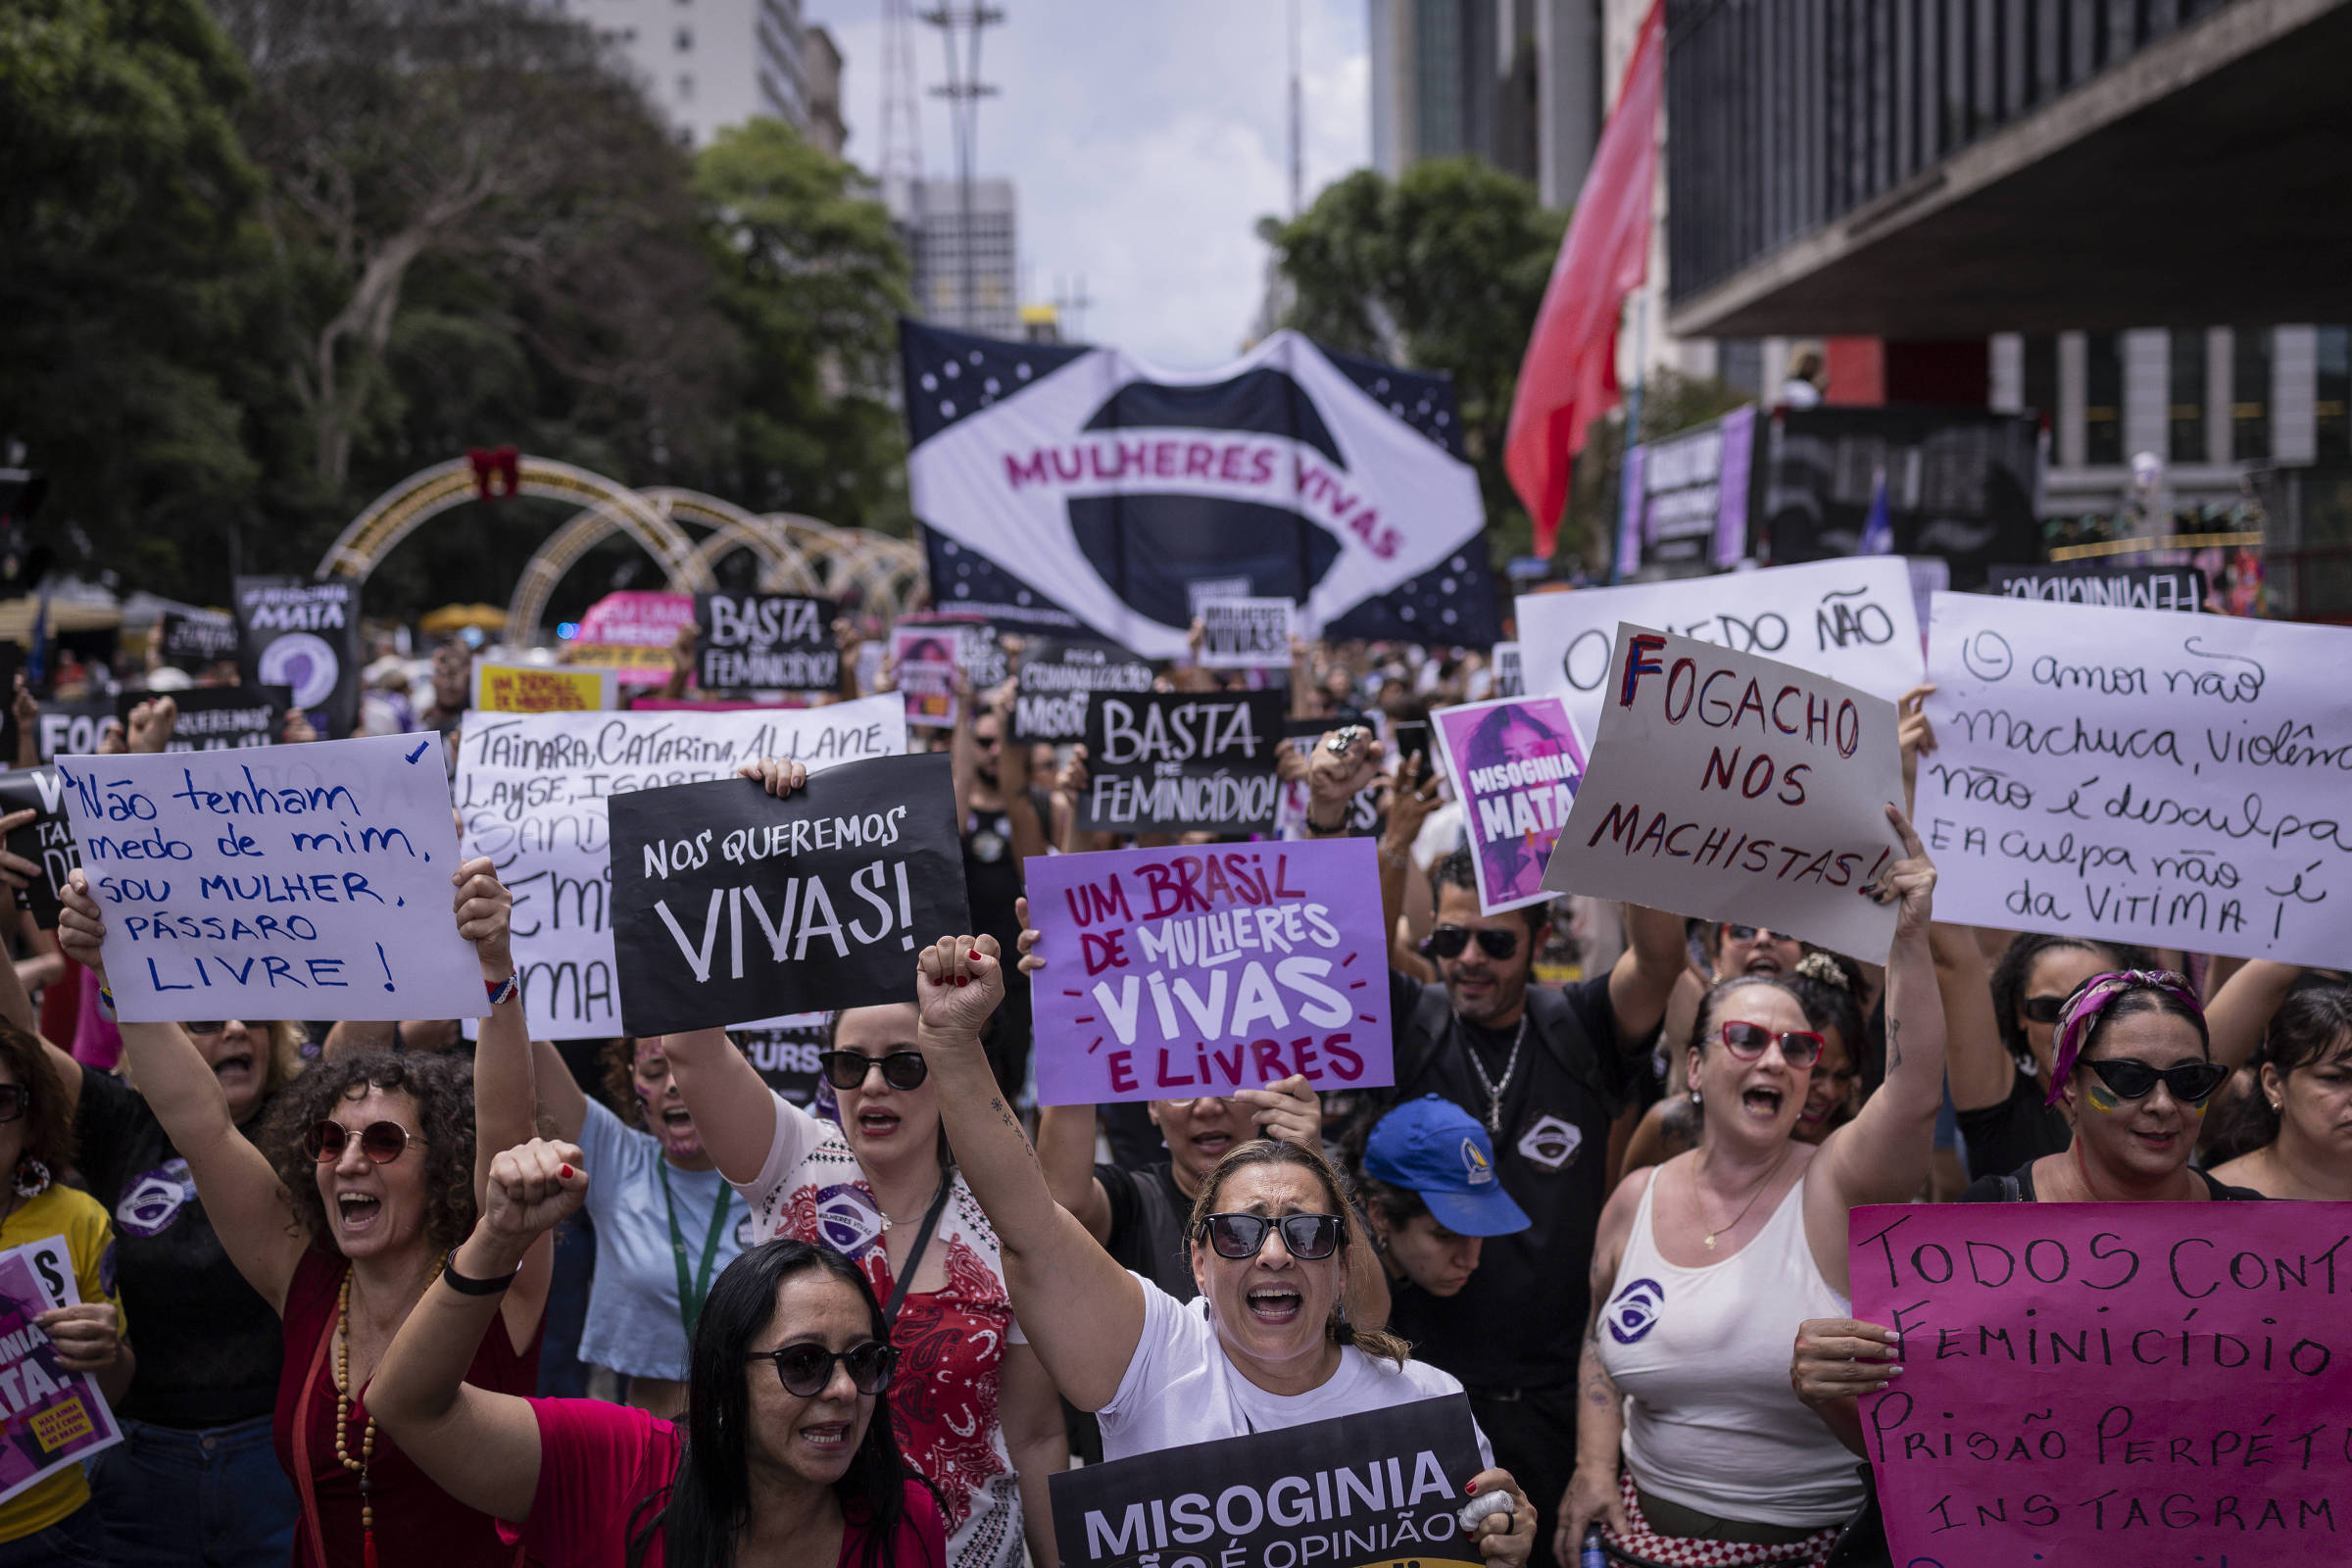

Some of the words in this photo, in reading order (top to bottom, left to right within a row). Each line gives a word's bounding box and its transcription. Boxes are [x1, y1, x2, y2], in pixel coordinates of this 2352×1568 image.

[1004, 438, 1276, 489] MULHERES
[1295, 455, 1400, 561] VIVAS
[709, 595, 822, 647] BASTA
[1563, 629, 1611, 690] O
[1817, 585, 1894, 652] NÃO
[1620, 634, 1859, 760] FOGACHO
[2033, 655, 2149, 695] amor
[2163, 636, 2266, 704] não
[1101, 699, 1263, 764] BASTA
[173, 764, 361, 816] tenham
[1090, 767, 1278, 823] FEMINICÍDIO!
[1469, 752, 1581, 795] MISOGINIA
[1700, 745, 1812, 807] NOS
[88, 827, 193, 861] medo
[218, 822, 264, 858] de
[643, 829, 711, 880] NOS
[721, 805, 906, 866] QUEREMOS
[1478, 783, 1575, 844] MATA
[2104, 782, 2352, 851] desculpa
[1587, 802, 1890, 896] MACHISTAS!
[1931, 819, 1955, 851] E
[1964, 827, 1986, 857] A
[2152, 850, 2242, 890] não
[98, 876, 171, 904] SOU
[1065, 872, 1134, 927] UM
[2006, 878, 2072, 922] da
[124, 911, 318, 941] PÁSSARO
[654, 860, 916, 983] VIVAS!
[1080, 928, 1130, 977] DE
[1137, 903, 1341, 969] MULHERES
[1108, 1050, 1139, 1093] E
[1858, 1215, 2140, 1290] TODOS
[1084, 1450, 1456, 1560] MISOGINIA
[1928, 1490, 2338, 1534] INSTAGRAM
[1263, 1510, 1455, 1568] OPINIÃO
